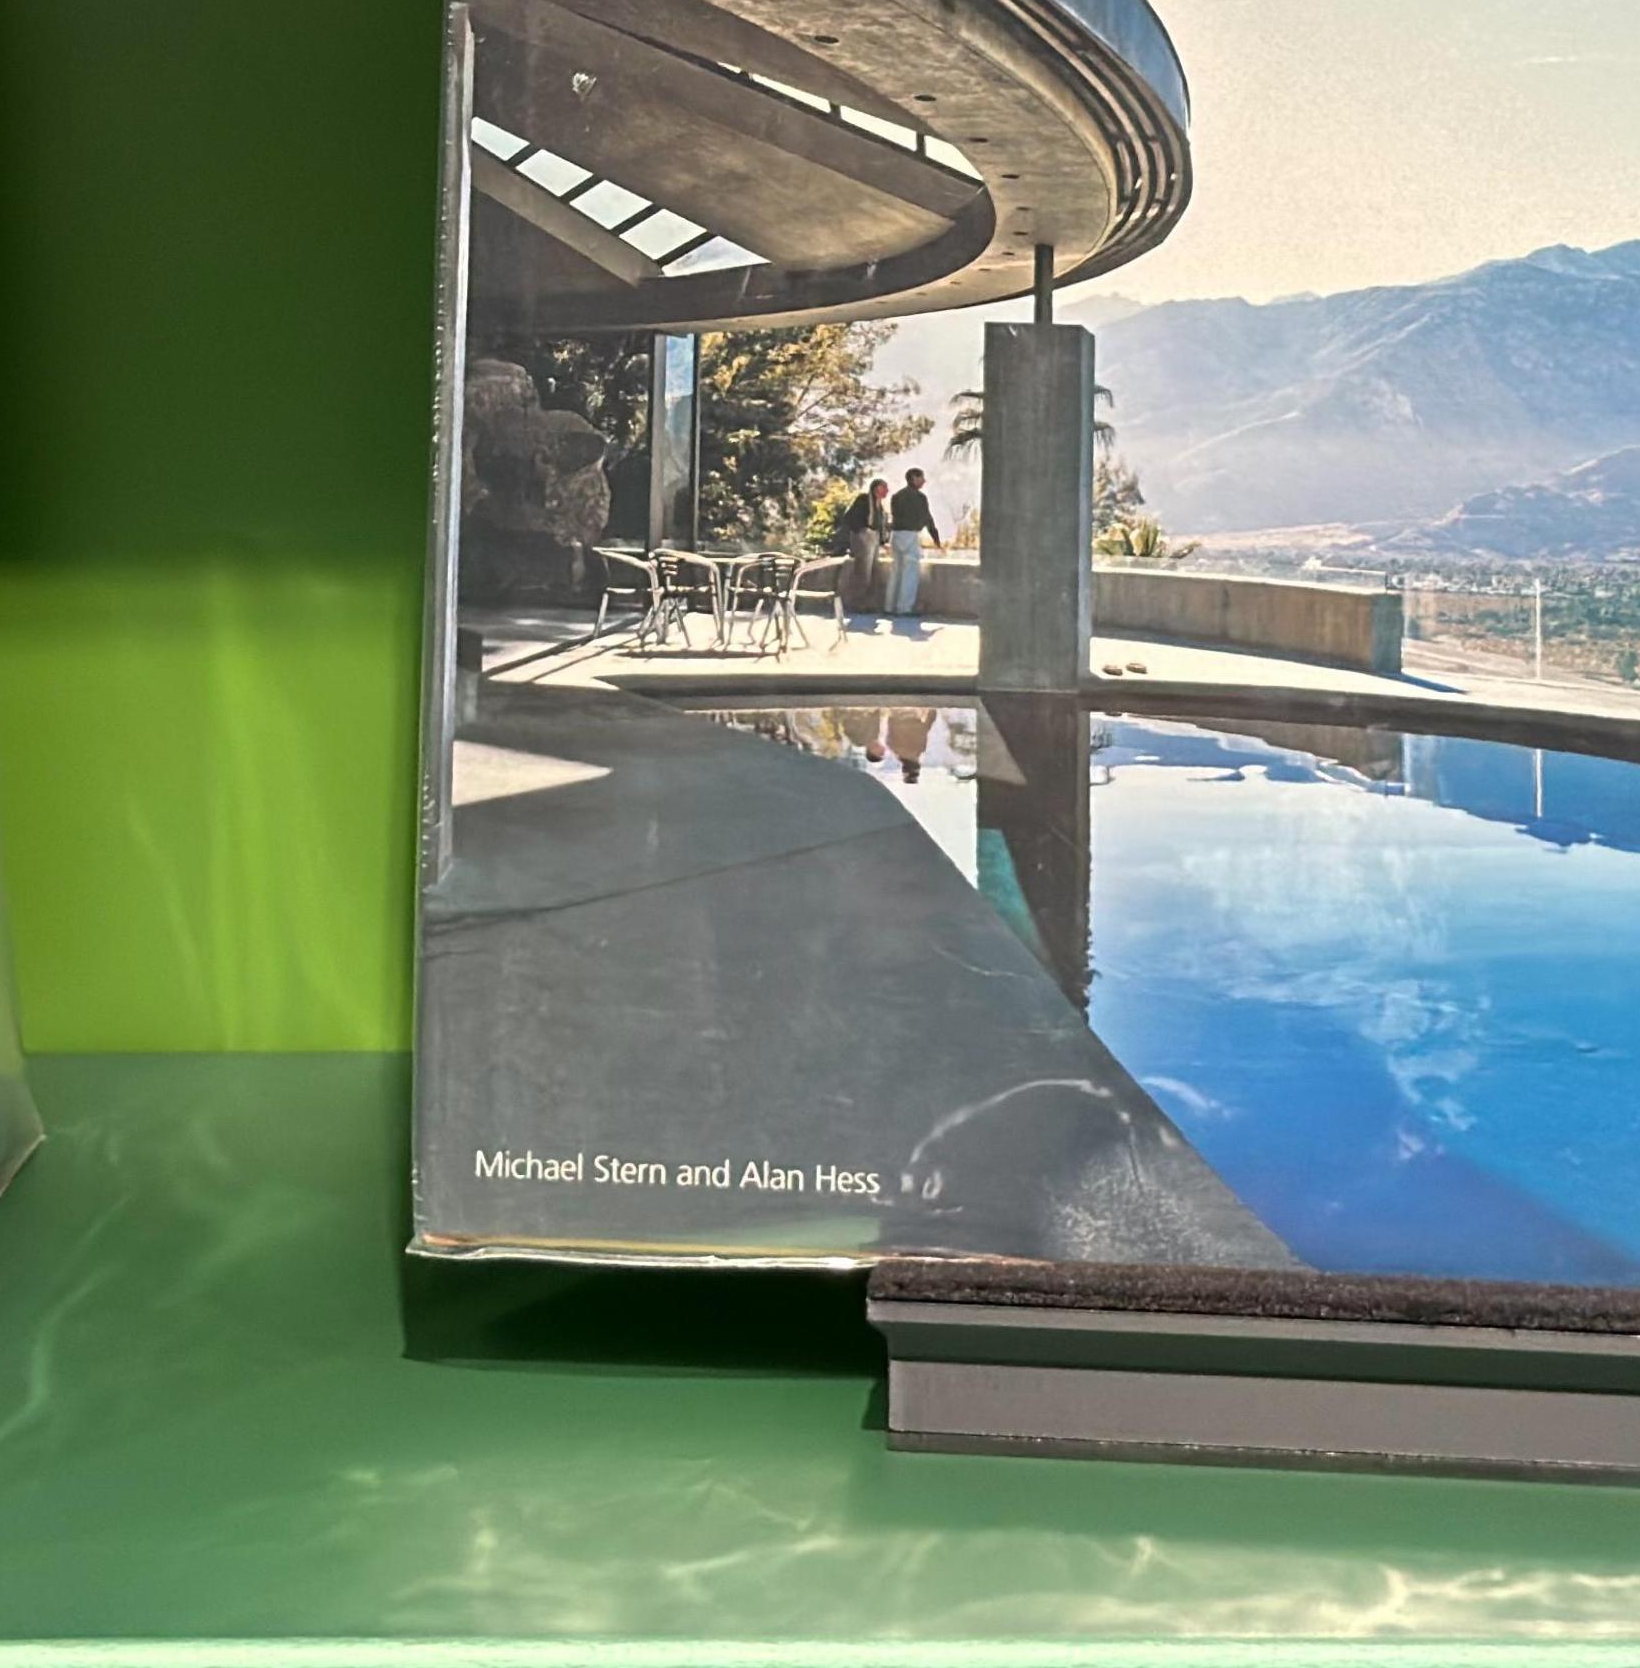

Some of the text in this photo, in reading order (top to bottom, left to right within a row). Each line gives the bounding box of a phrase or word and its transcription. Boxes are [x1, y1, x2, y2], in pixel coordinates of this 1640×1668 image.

[474, 1149, 881, 1194] Michael Stern and Alan Hess
